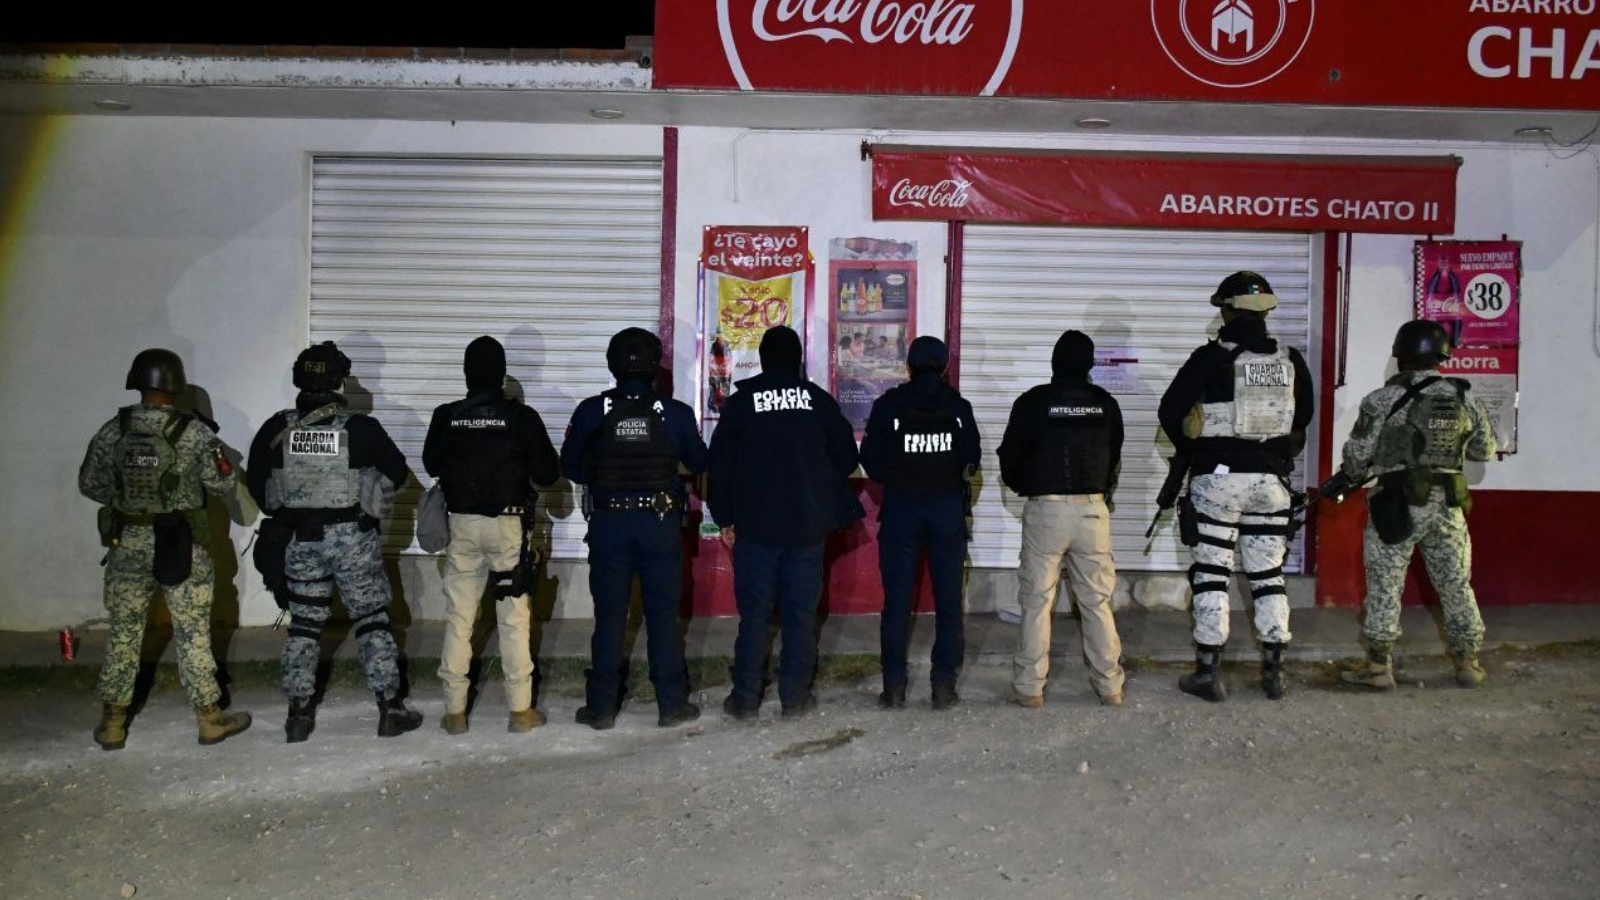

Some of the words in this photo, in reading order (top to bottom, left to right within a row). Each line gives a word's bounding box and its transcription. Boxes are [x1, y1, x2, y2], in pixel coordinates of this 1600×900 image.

[1160, 193, 1319, 218] ABARROTES
[1327, 198, 1415, 221] CHATO
[1423, 202, 1438, 221] II
[708, 252, 726, 267] el
[731, 252, 804, 268] veinte?
[1249, 364, 1284, 375] GUARDIA
[1248, 374, 1287, 386] NACIONAL
[755, 399, 813, 413] ESTATAL
[1050, 406, 1103, 414] INTELIGENCIA
[451, 419, 506, 427] INTELIGENCIA
[293, 432, 335, 443] GUARDIA
[616, 428, 648, 436] ESTATAL
[291, 443, 337, 454] NACIONAL
[904, 442, 952, 452] ESTATAL
